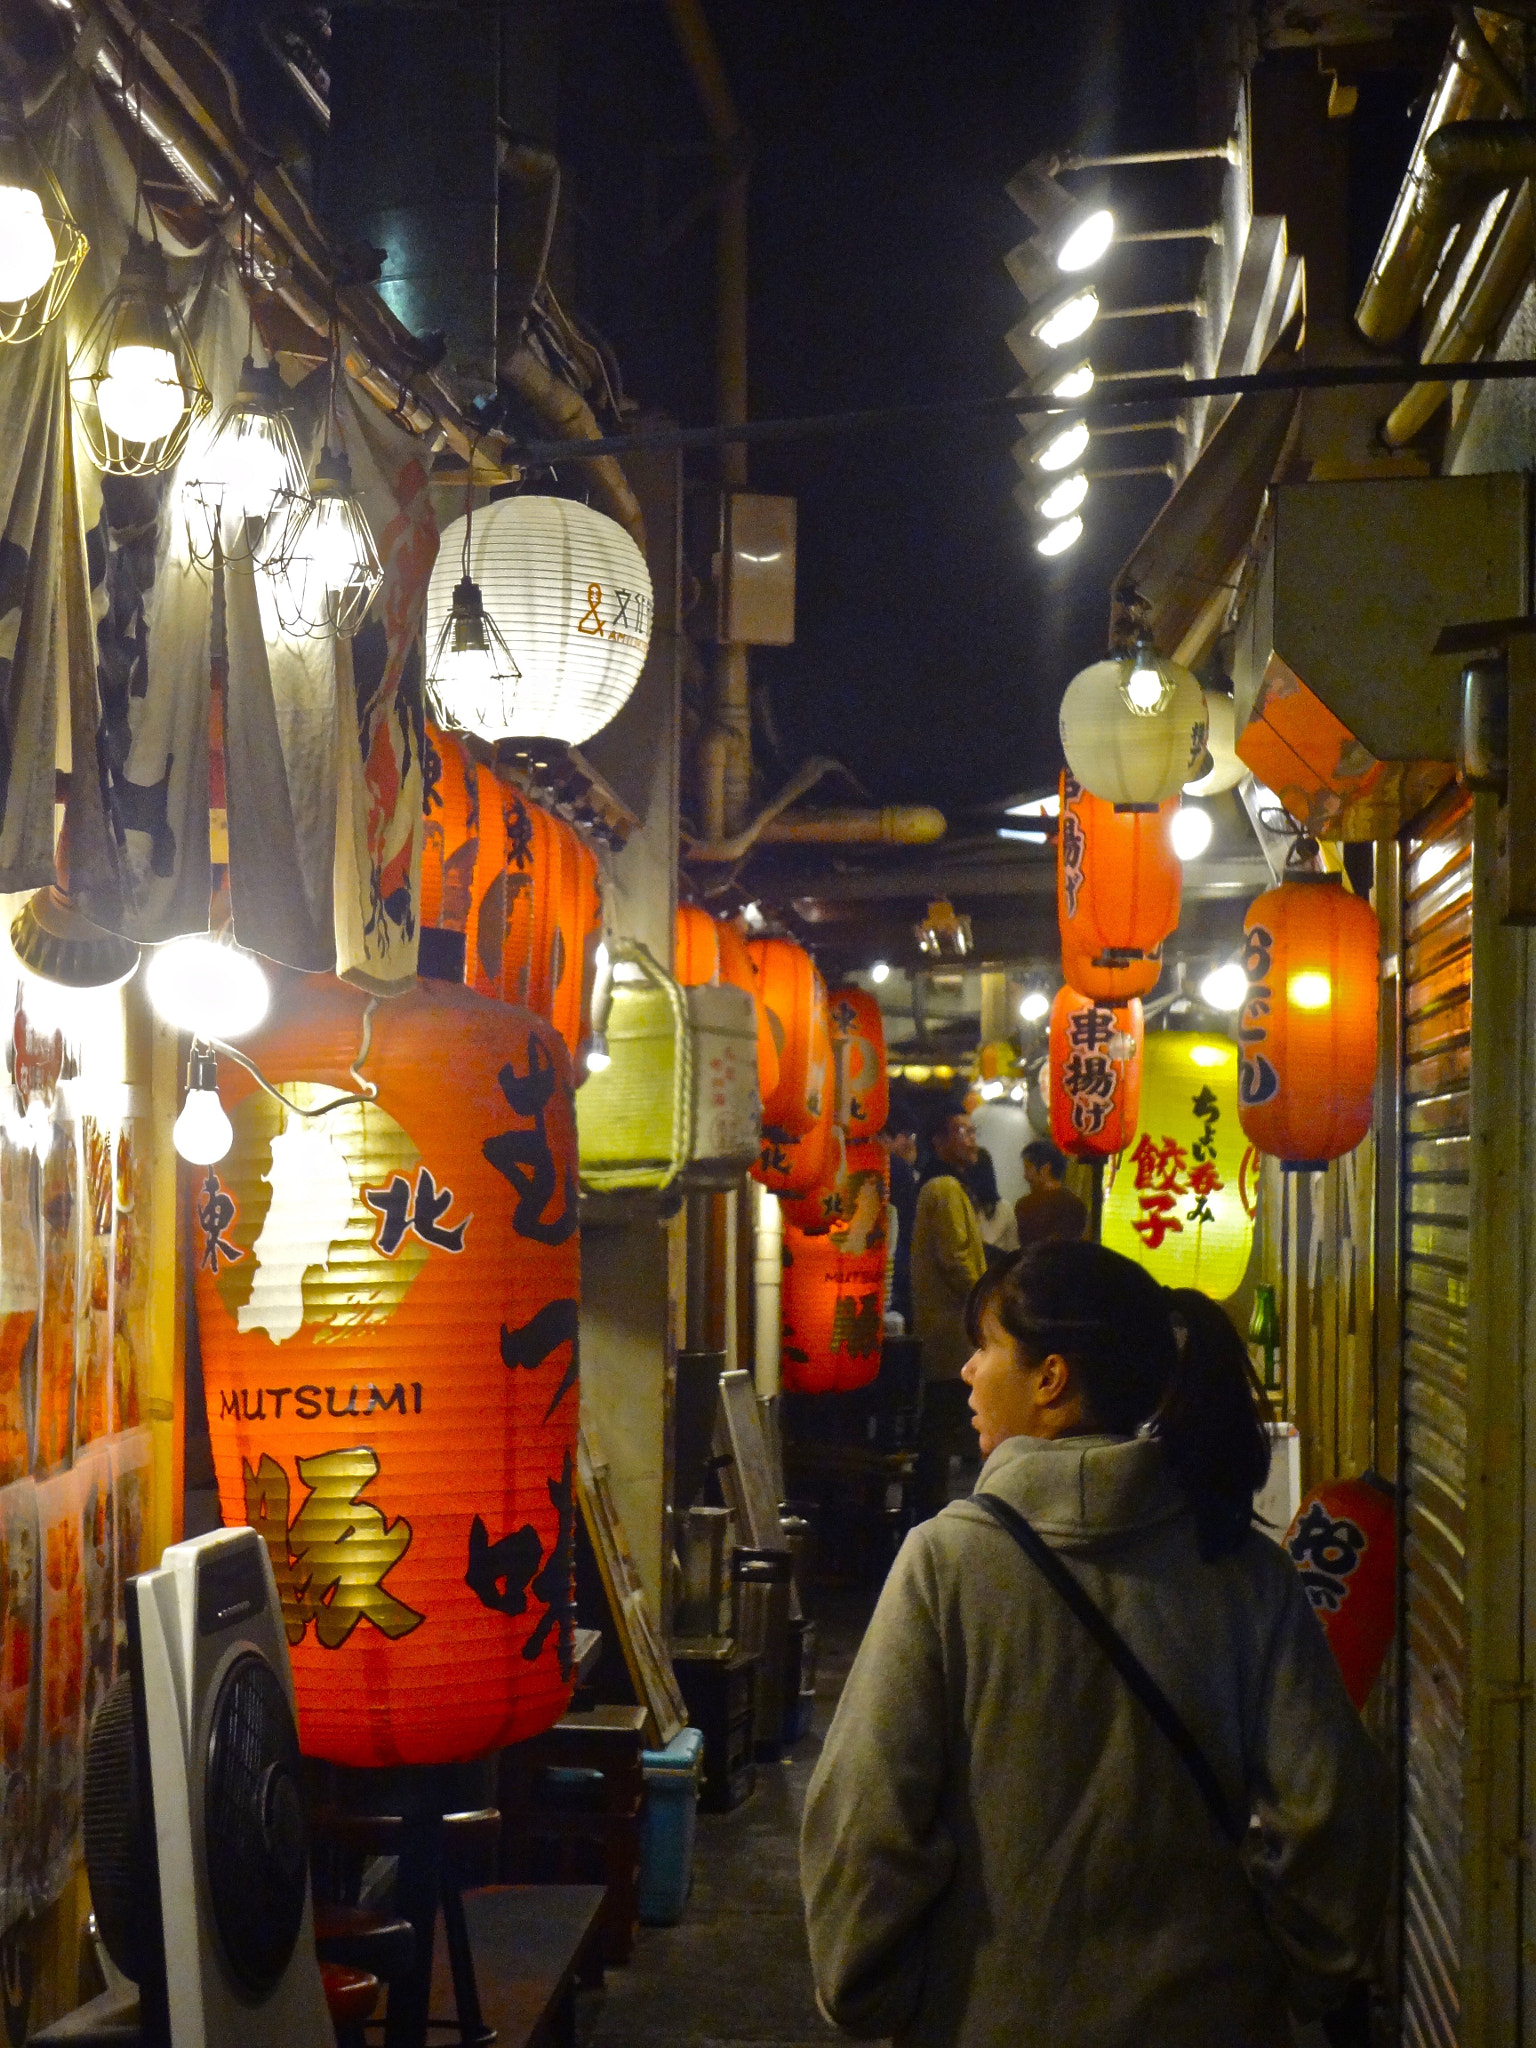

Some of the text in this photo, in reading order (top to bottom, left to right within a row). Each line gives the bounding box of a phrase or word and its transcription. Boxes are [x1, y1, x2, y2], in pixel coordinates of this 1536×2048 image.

[198, 1165, 474, 1274] 東 北
[1129, 1133, 1188, 1249] 餃子
[219, 1381, 423, 1421] MUTSUMI
